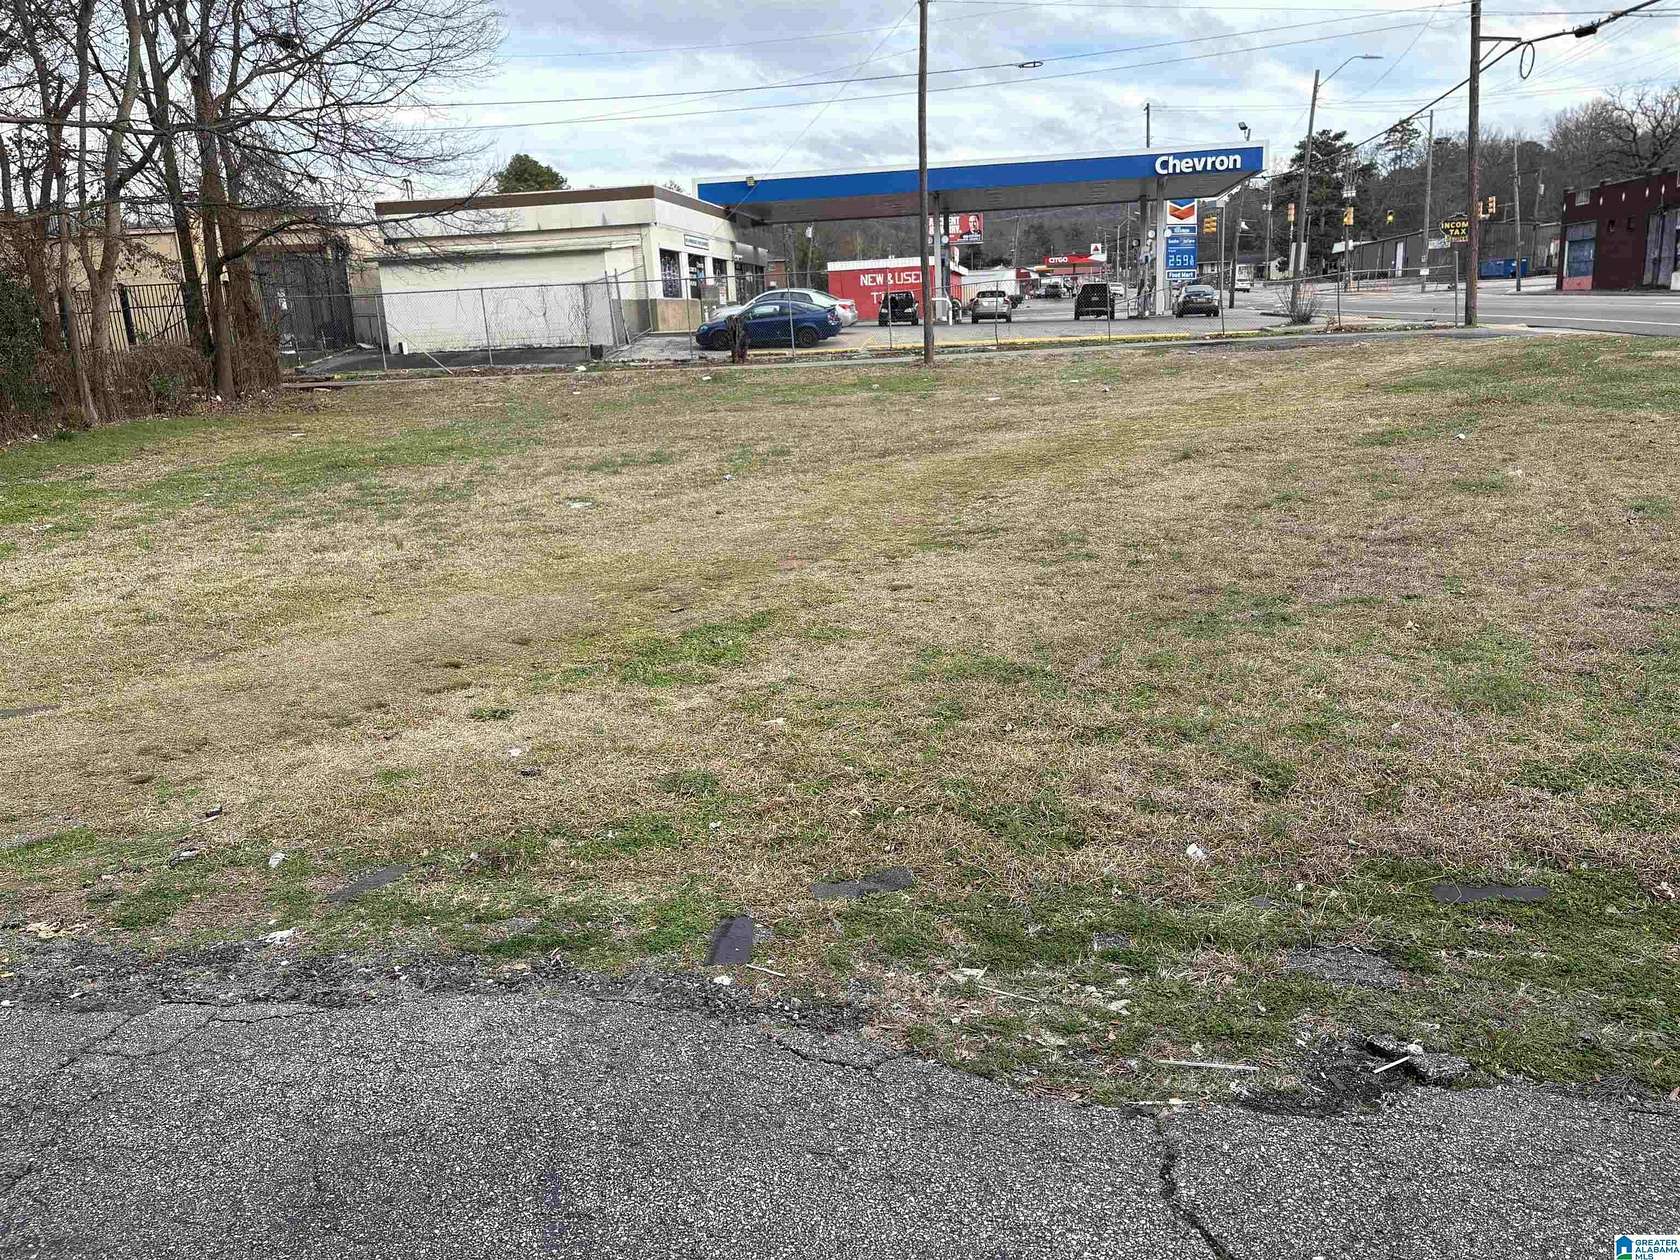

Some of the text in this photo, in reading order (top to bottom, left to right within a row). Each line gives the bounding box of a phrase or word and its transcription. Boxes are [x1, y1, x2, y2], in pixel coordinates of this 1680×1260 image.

[1155, 154, 1242, 175] Chevron
[1441, 221, 1469, 229] INCOM
[1449, 228, 1467, 236] TAX
[860, 273, 884, 286] NEW
[895, 271, 923, 284] USE
